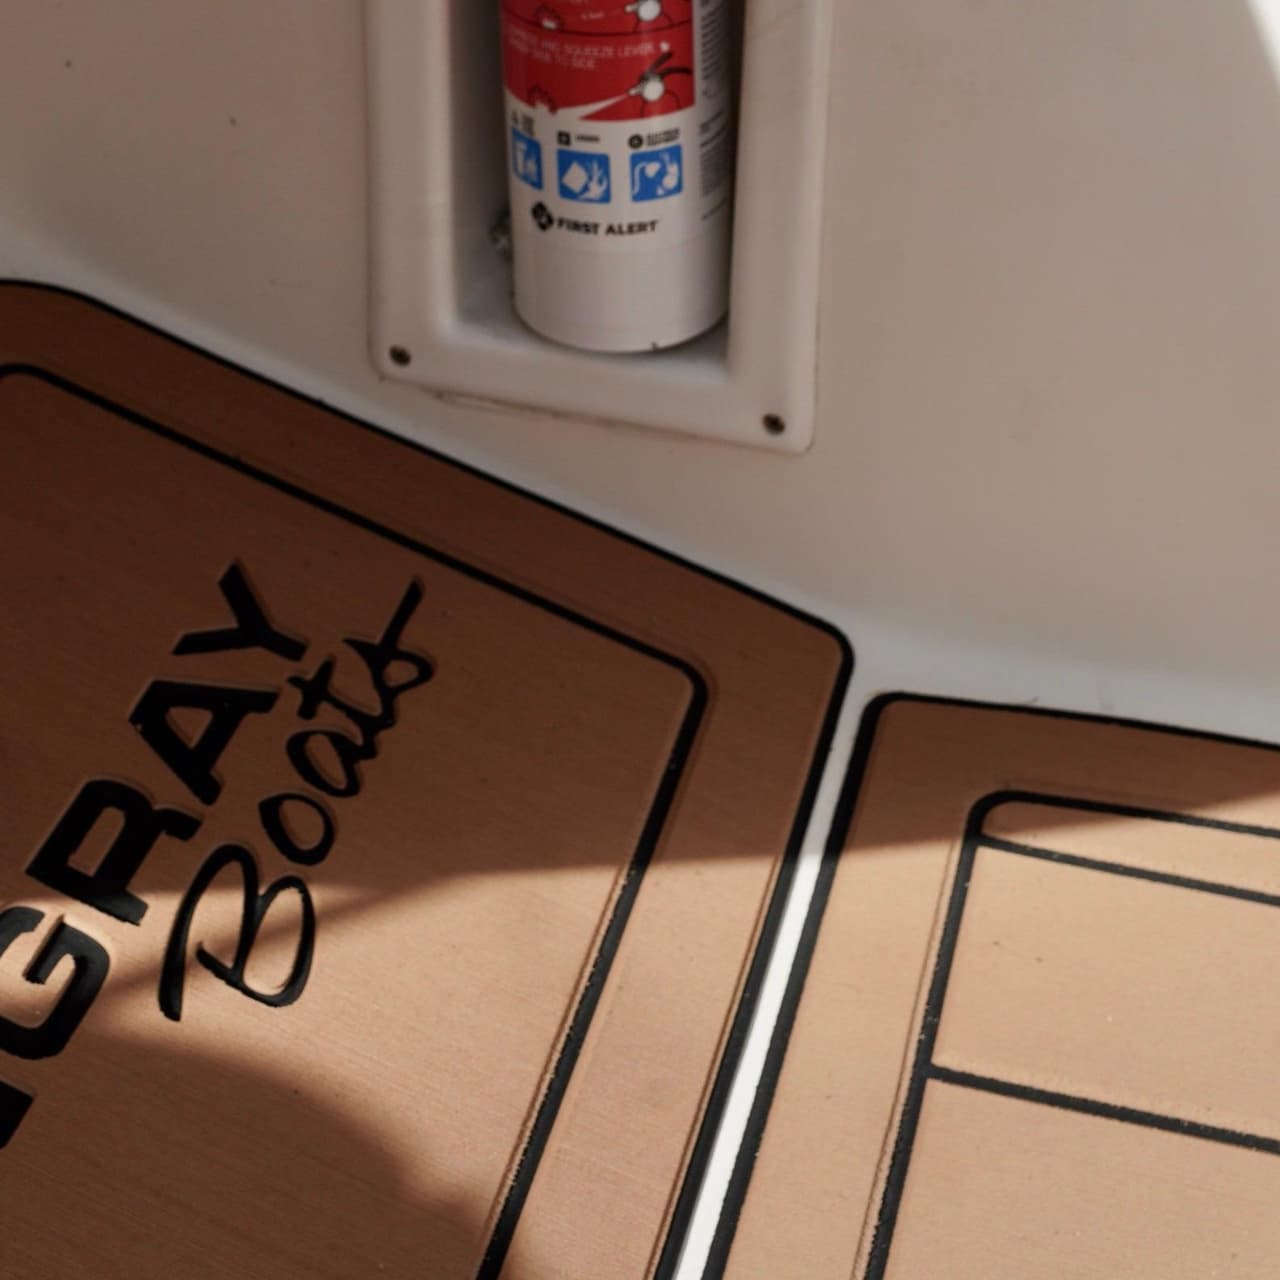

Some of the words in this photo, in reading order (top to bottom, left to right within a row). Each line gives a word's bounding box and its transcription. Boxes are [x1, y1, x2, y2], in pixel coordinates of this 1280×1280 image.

[556, 216, 600, 236] FIRST
[604, 217, 660, 237] ALERT
[158, 576, 435, 1022] Boats
